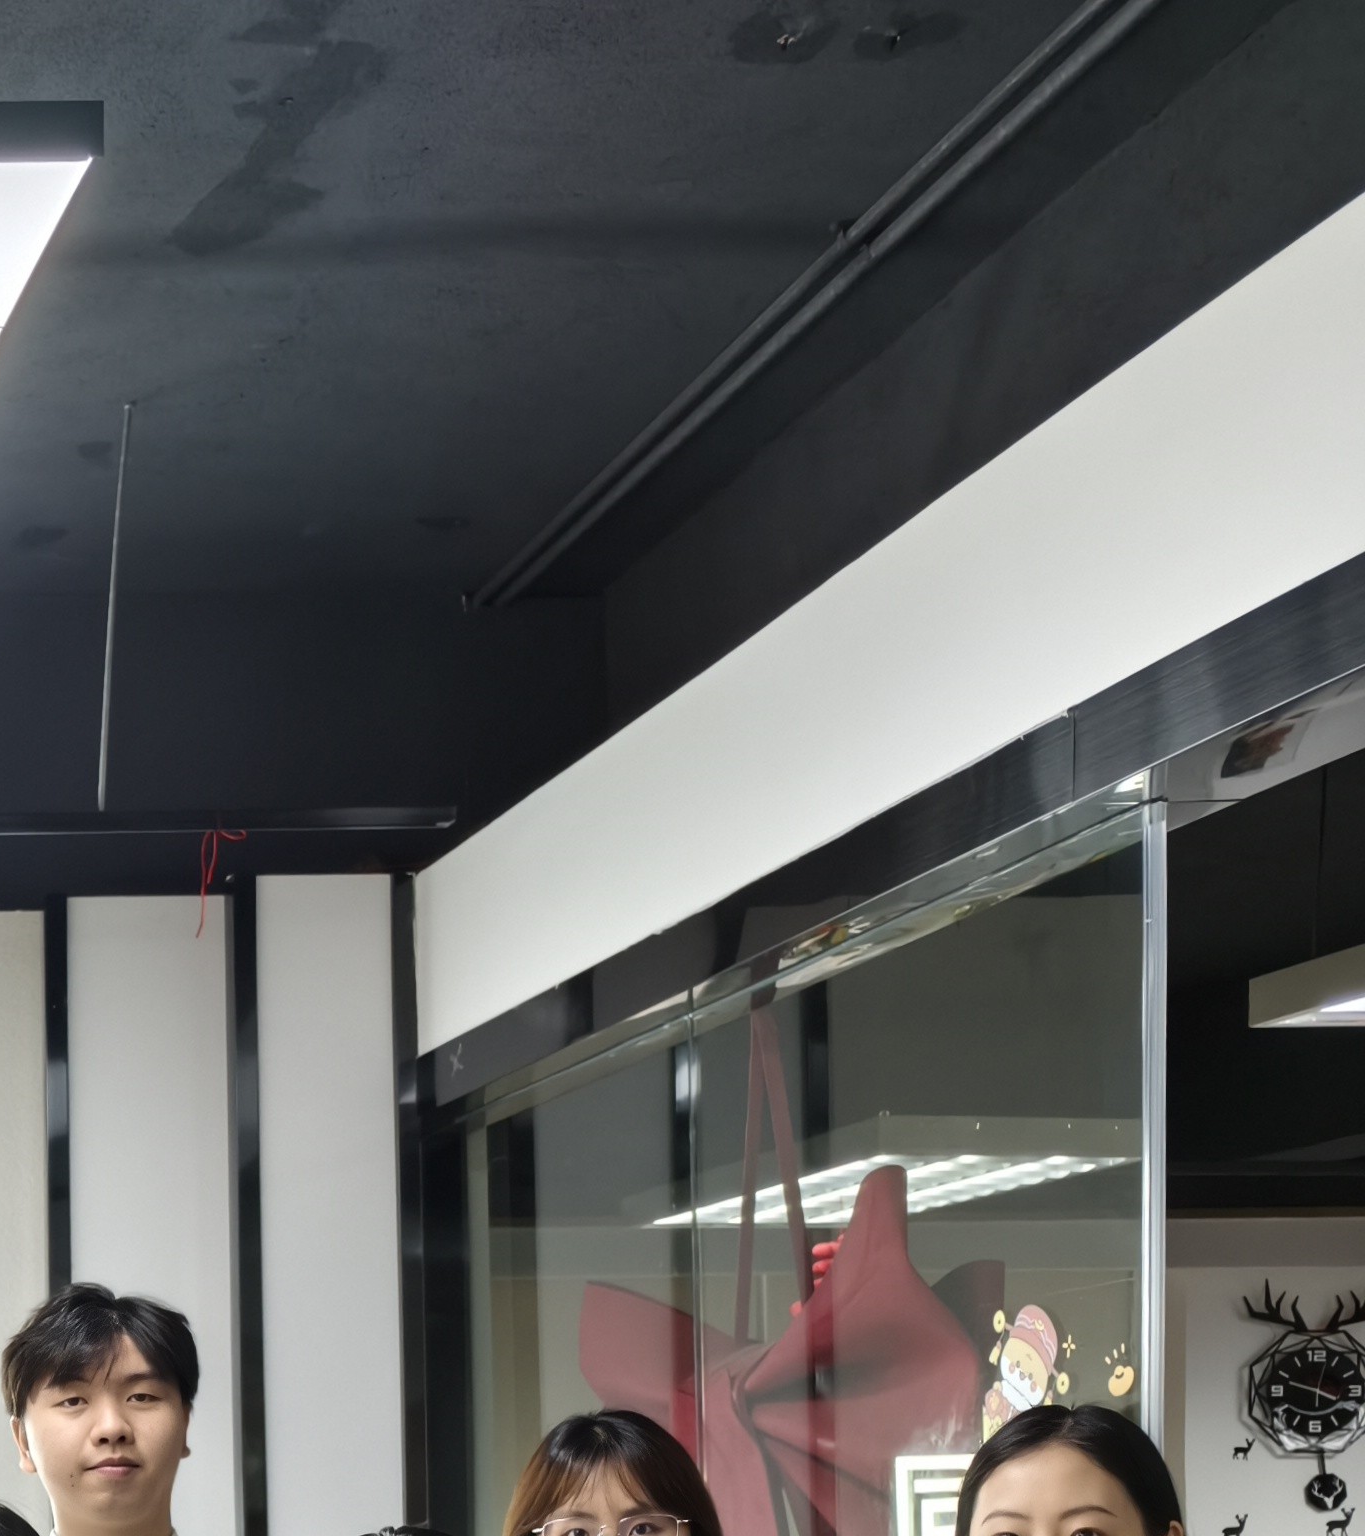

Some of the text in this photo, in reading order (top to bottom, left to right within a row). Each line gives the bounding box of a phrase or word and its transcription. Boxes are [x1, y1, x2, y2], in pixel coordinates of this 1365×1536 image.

[1306, 1350, 1327, 1363] 12
[1271, 1384, 1284, 1398] 9
[1348, 1384, 1362, 1398] 3
[1309, 1420, 1322, 1433] 6
